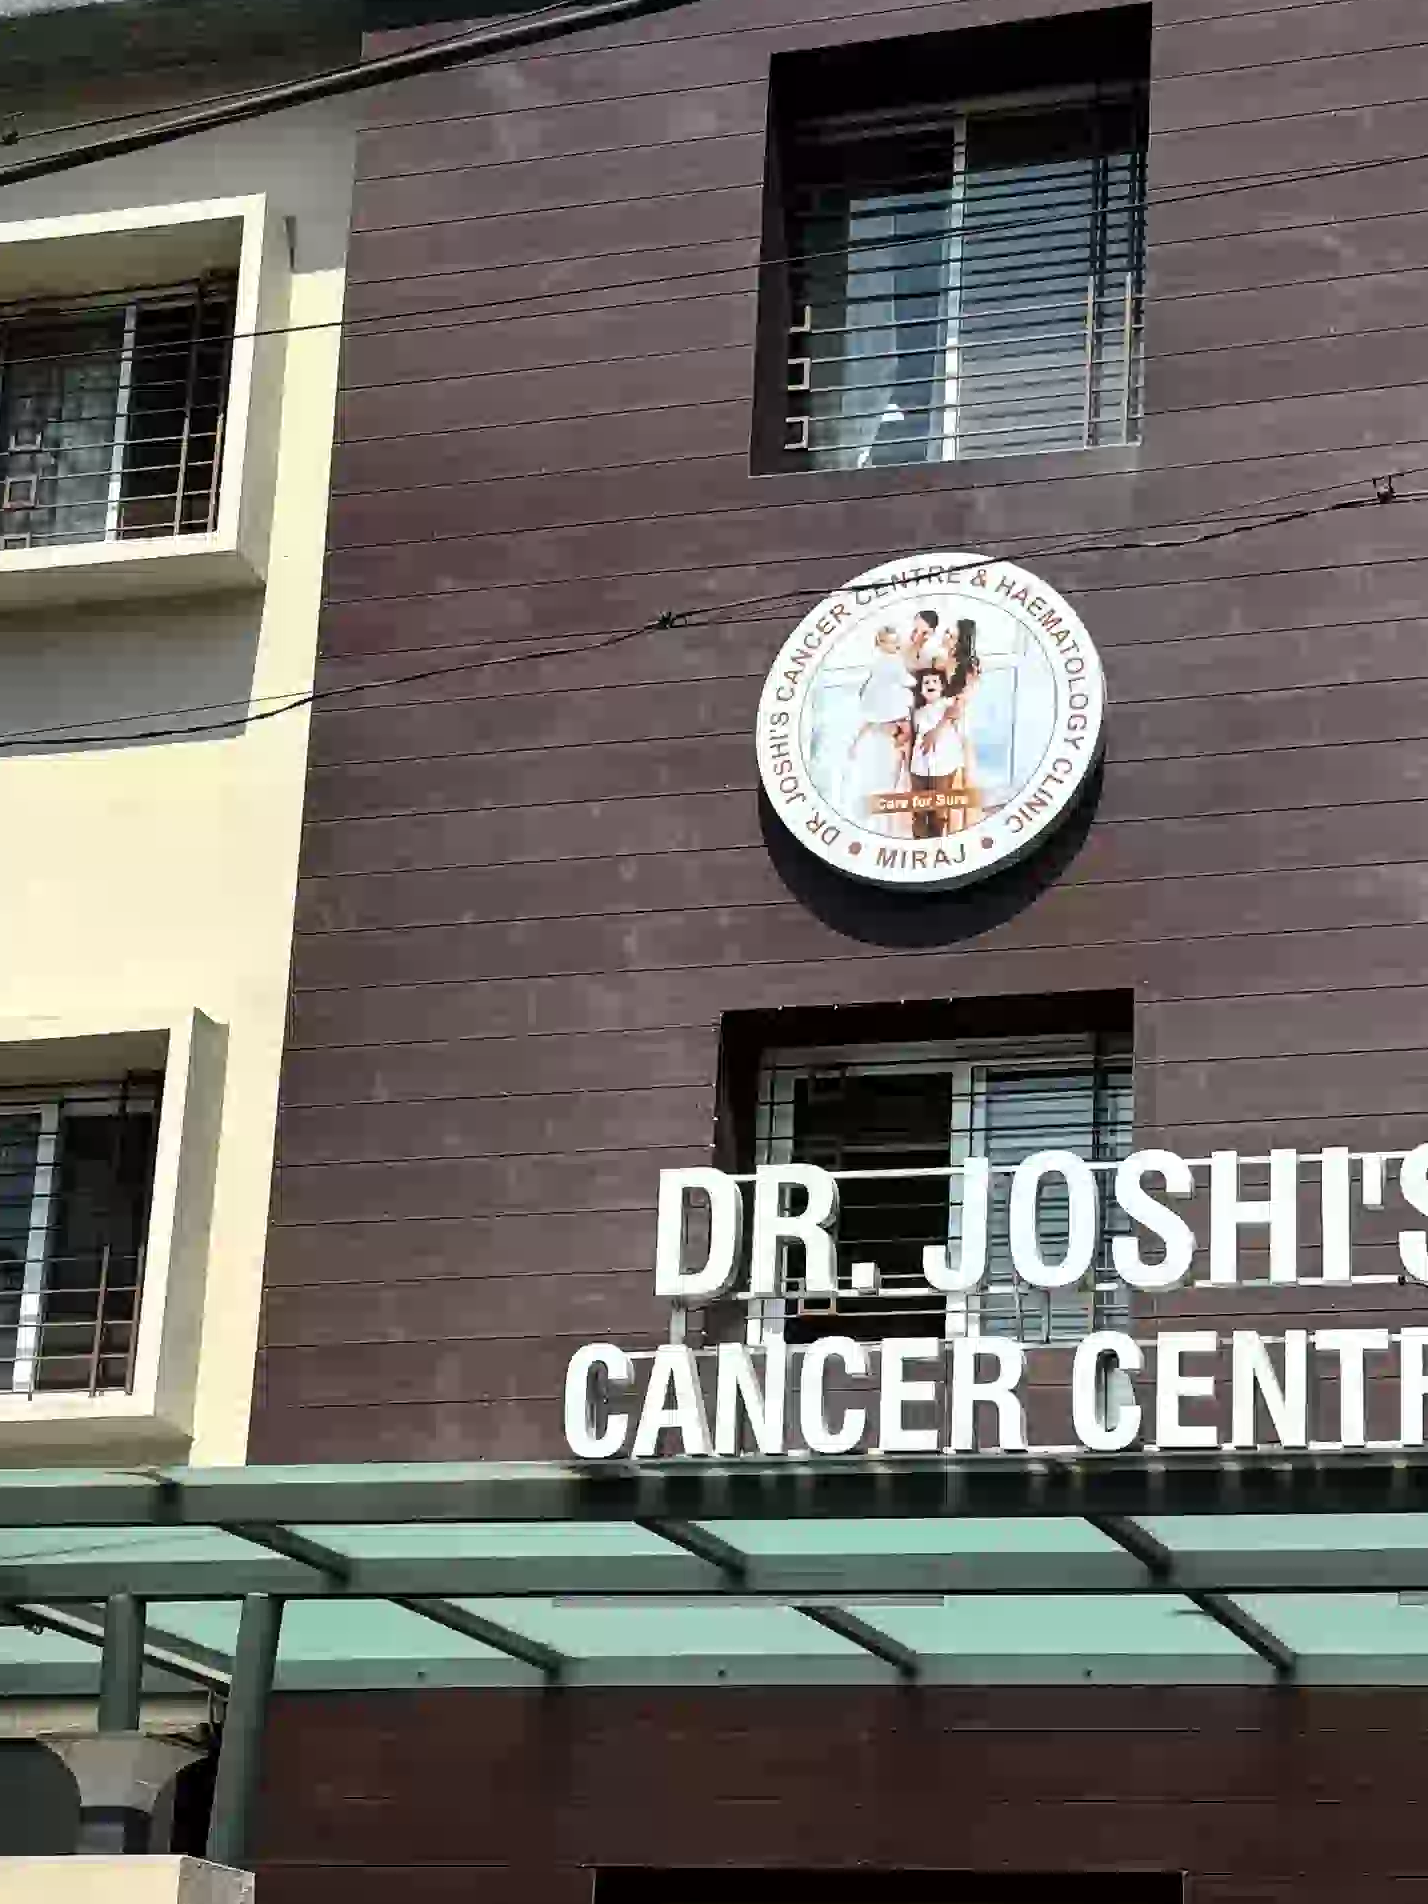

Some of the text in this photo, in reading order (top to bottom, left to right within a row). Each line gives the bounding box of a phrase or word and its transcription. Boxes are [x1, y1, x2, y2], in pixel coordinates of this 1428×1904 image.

[855, 564, 961, 605] CENTRE
[970, 568, 987, 588] &
[776, 603, 852, 701] CANCER
[995, 575, 1089, 750] HAEMATOLOGY
[770, 711, 807, 804] JOSHI'S
[1005, 757, 1073, 833] CLINIC
[876, 843, 967, 870] MIRAJ
[655, 1163, 881, 1298] DR.
[563, 1335, 1029, 1458] CANCER
